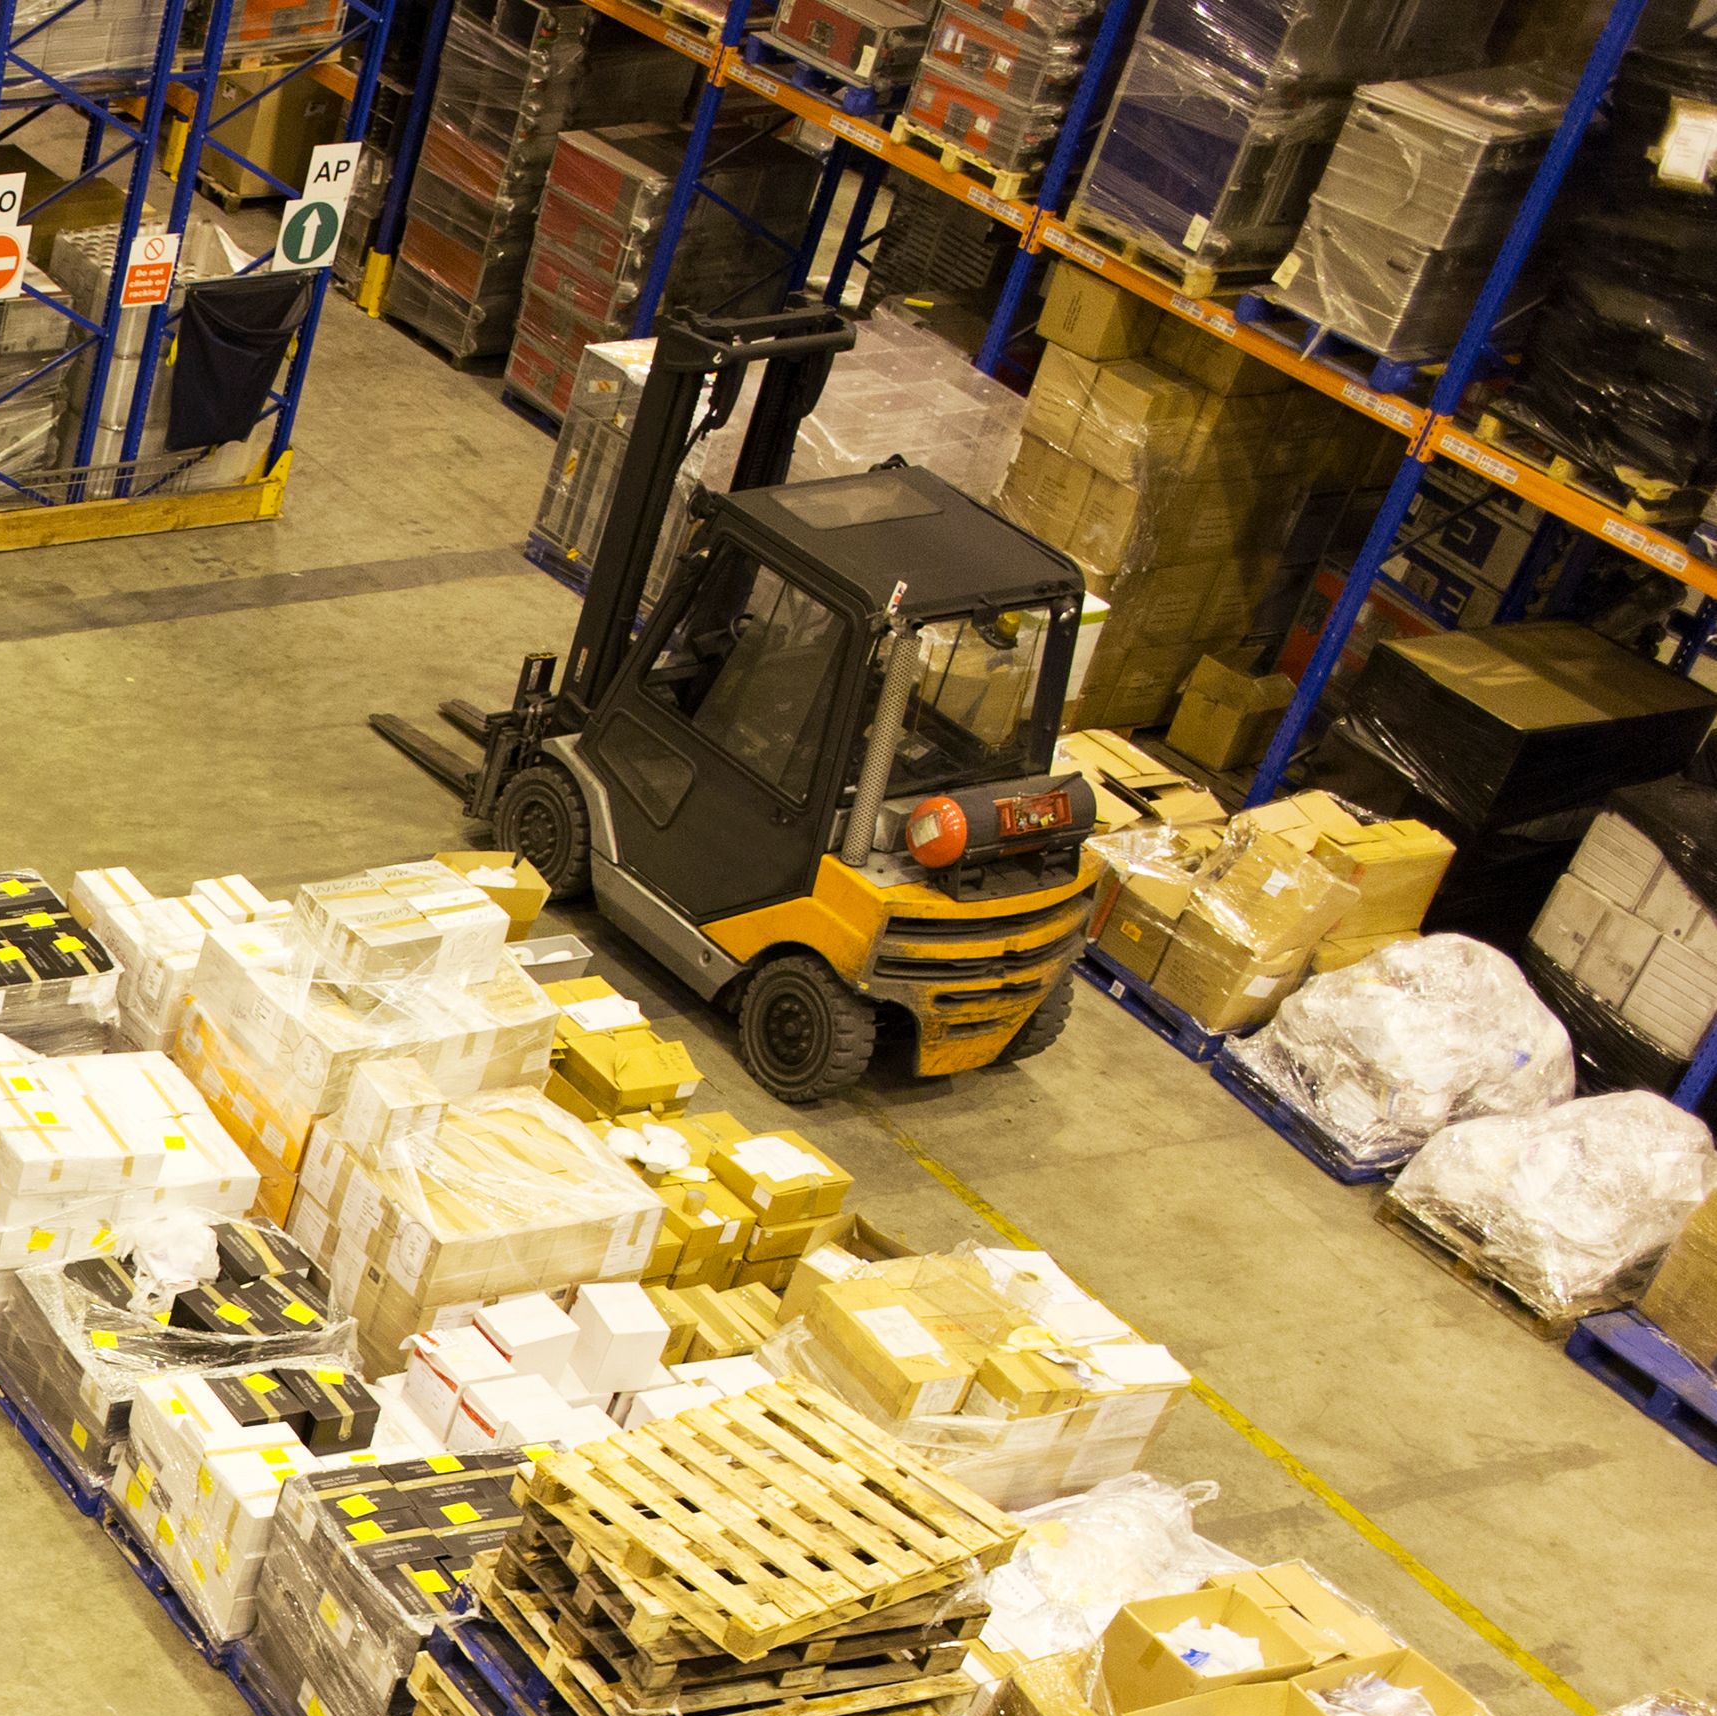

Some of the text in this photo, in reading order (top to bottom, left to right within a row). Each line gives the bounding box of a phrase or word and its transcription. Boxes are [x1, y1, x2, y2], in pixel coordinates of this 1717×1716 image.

[314, 160, 351, 183] AP
[149, 268, 164, 276] not
[128, 279, 153, 288] climb
[128, 289, 162, 298] racking
